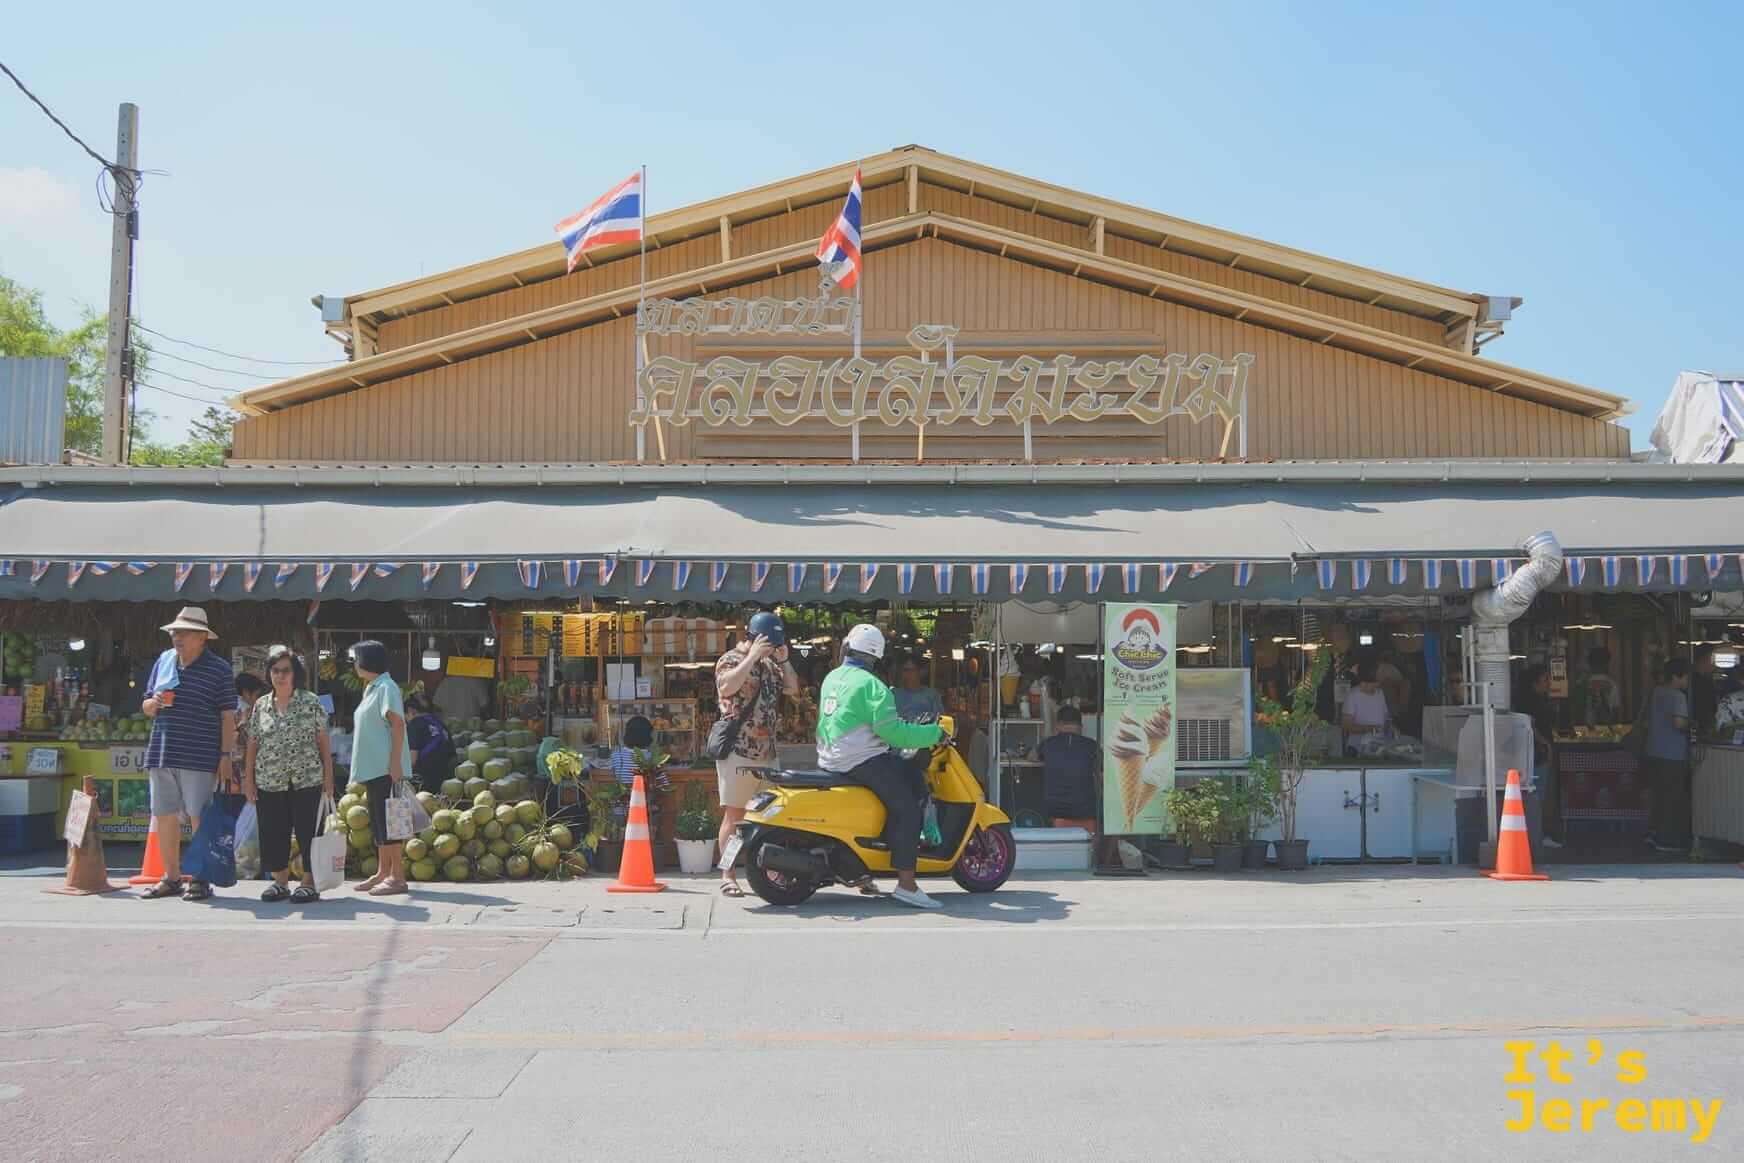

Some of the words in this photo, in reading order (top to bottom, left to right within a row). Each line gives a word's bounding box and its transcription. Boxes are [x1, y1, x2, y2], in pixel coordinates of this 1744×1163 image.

[628, 323, 1255, 428] คลองลัดมะยม
